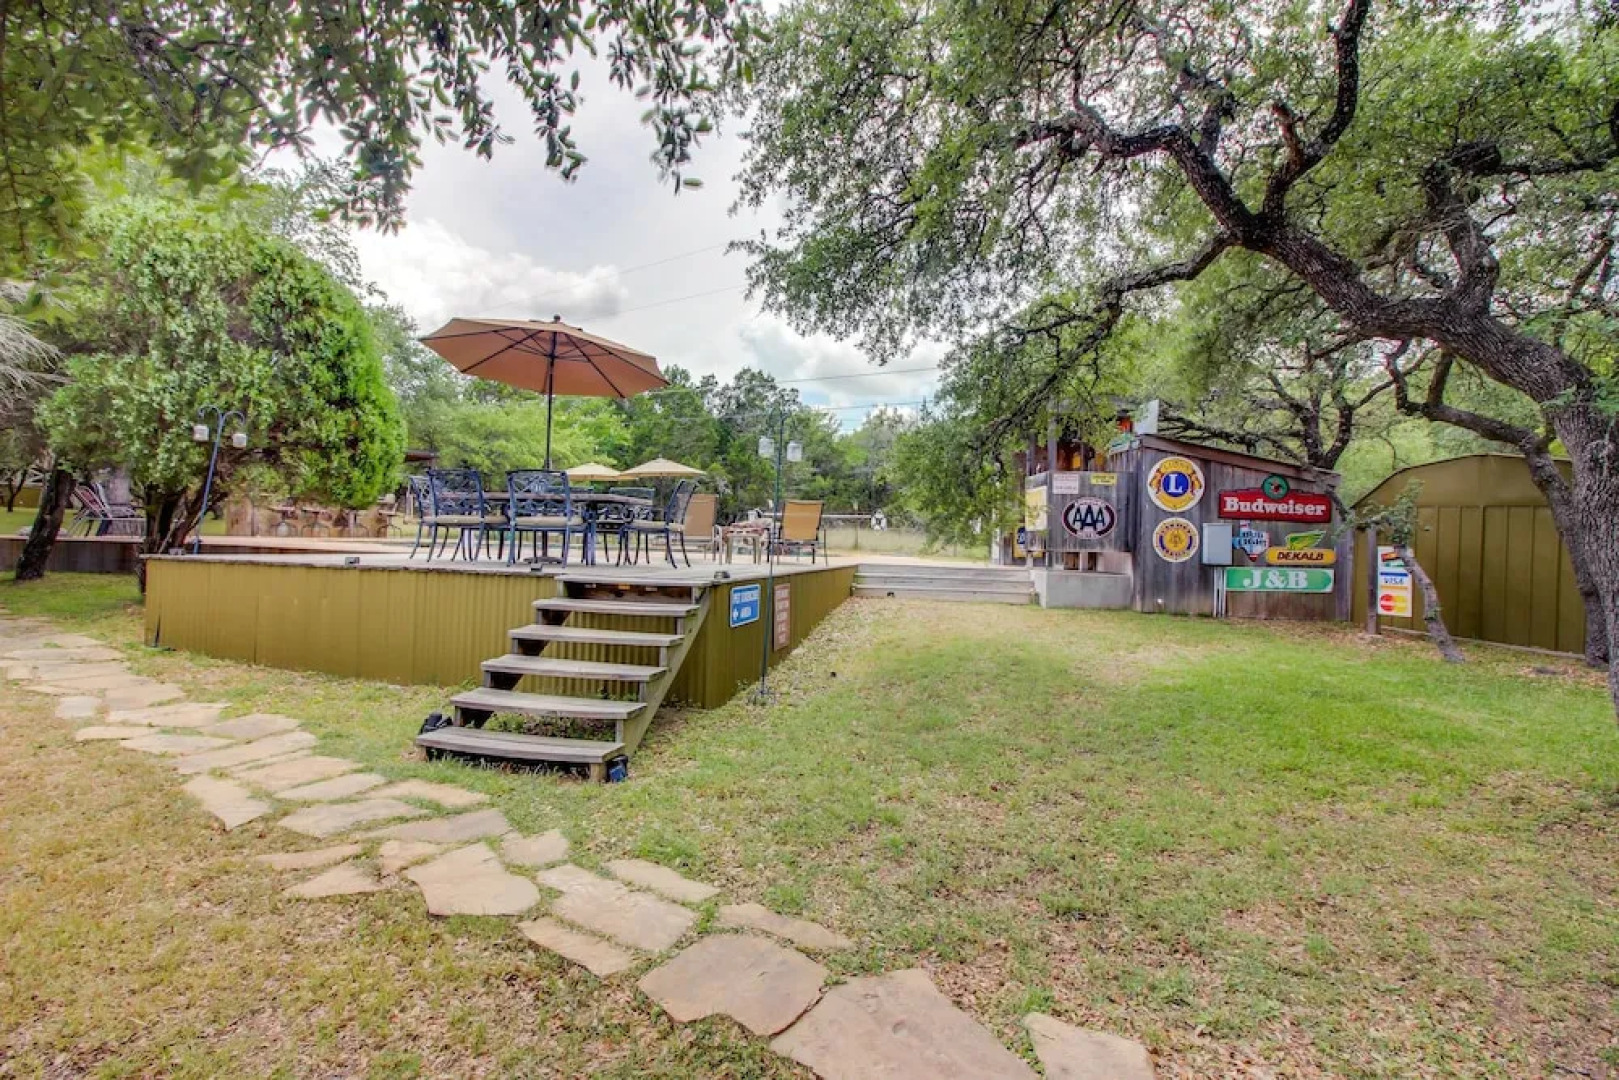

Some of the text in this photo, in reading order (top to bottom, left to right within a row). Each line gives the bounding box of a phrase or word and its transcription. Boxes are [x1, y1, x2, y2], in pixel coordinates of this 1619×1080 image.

[1168, 474, 1183, 493] L
[1223, 496, 1327, 516] Budweiser
[1072, 504, 1106, 531] AAA
[1277, 551, 1324, 561] DEKALB
[1242, 569, 1309, 590] J&B
